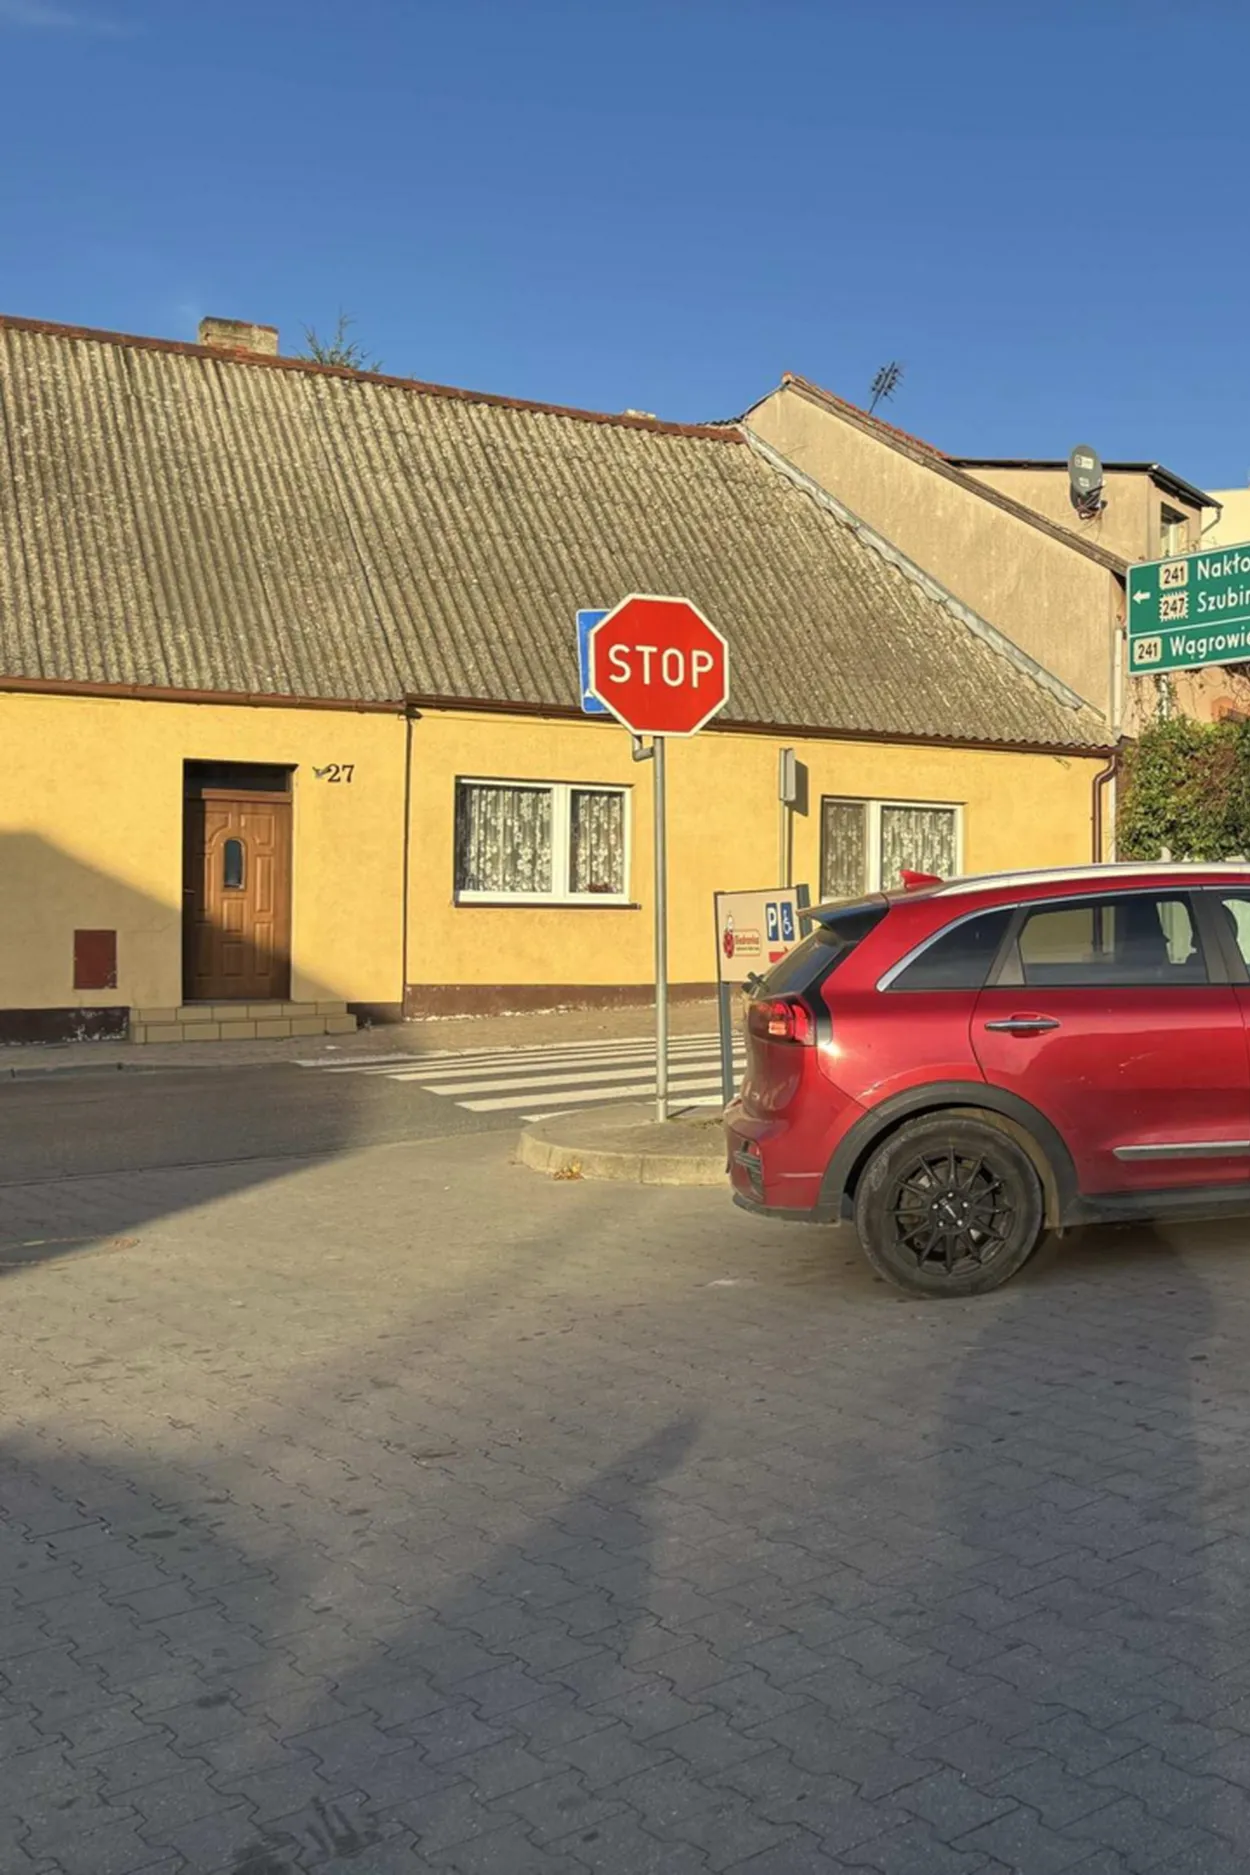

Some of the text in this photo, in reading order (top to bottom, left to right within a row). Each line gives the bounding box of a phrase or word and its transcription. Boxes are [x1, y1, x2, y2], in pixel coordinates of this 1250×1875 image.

[1164, 567, 1185, 584] 241
[1163, 597, 1185, 616] 247
[1138, 642, 1158, 660] 241
[608, 643, 714, 688] STOP
[327, 763, 355, 783] 27
